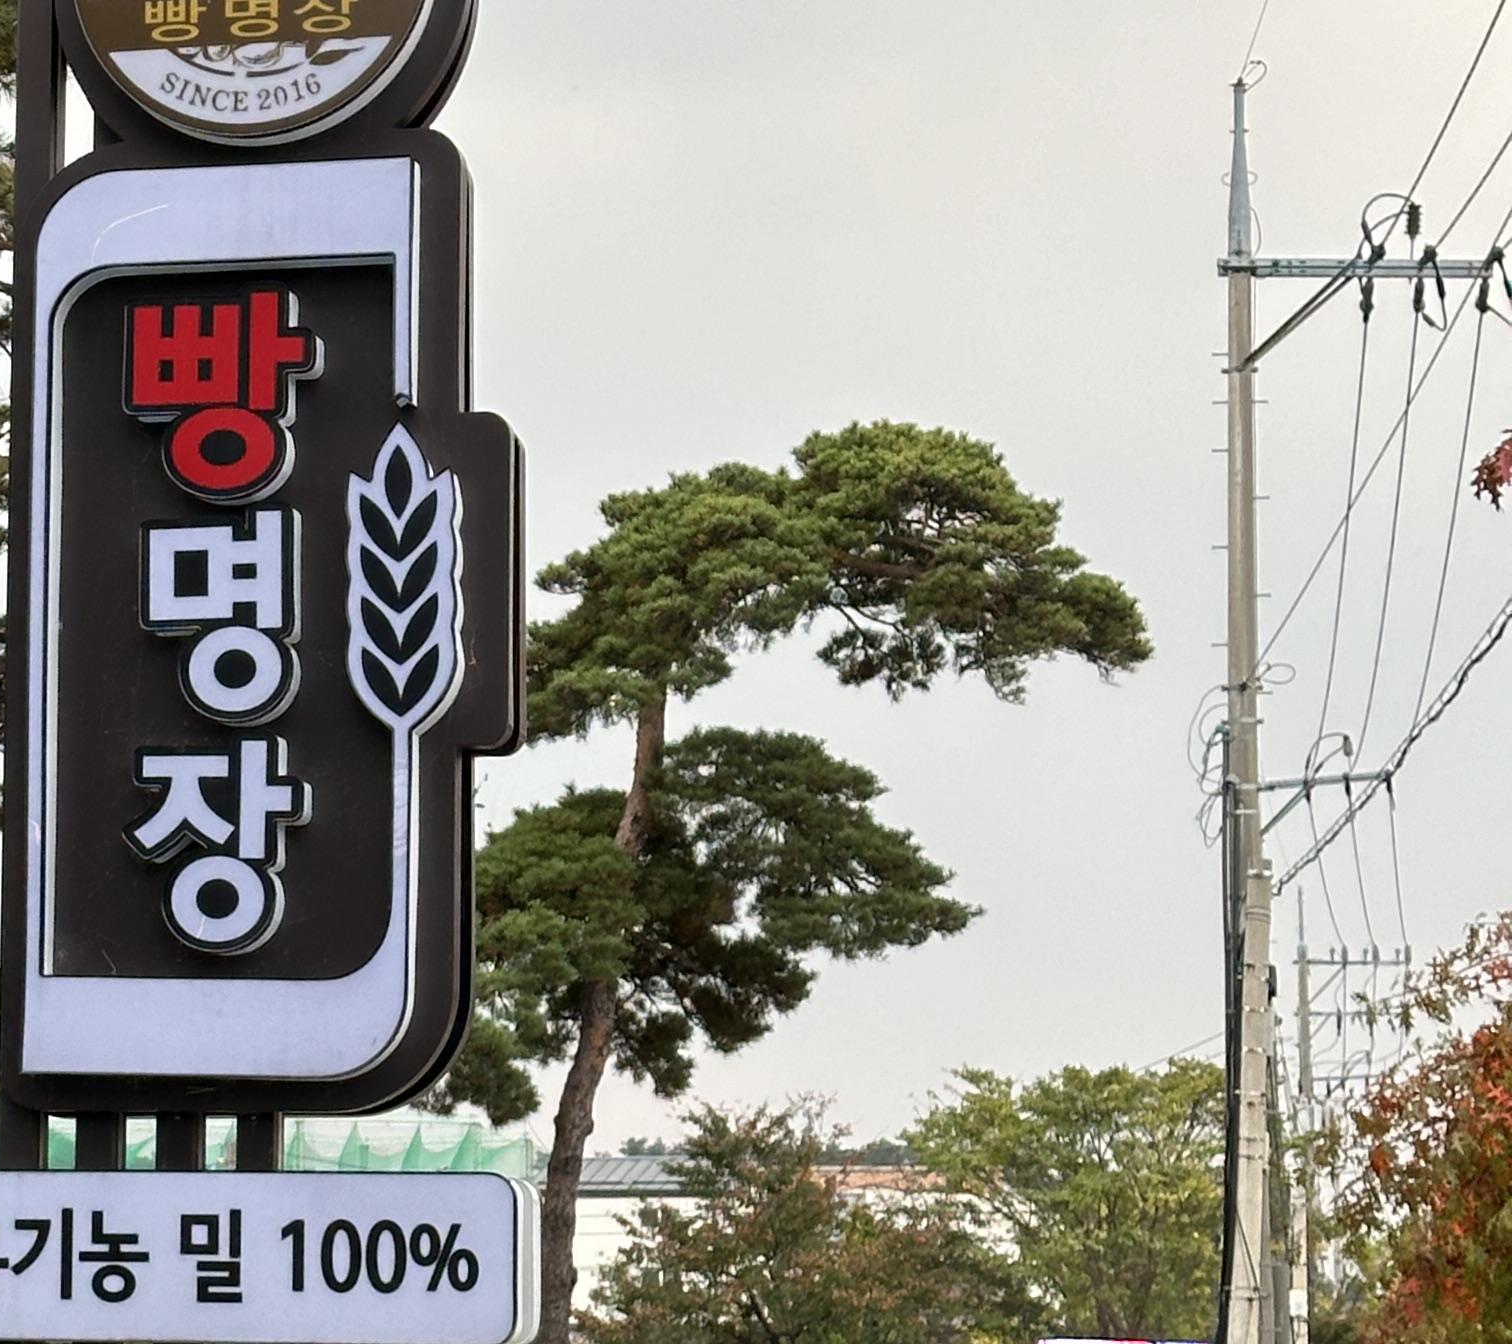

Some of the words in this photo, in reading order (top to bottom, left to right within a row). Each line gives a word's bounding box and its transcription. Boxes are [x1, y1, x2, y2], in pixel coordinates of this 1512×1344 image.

[159, 72, 249, 112] SINCE
[256, 72, 322, 111] 2016
[131, 291, 306, 943] 빵명장
[180, 1208, 243, 1304] 밀
[280, 1218, 480, 1294] 100%
